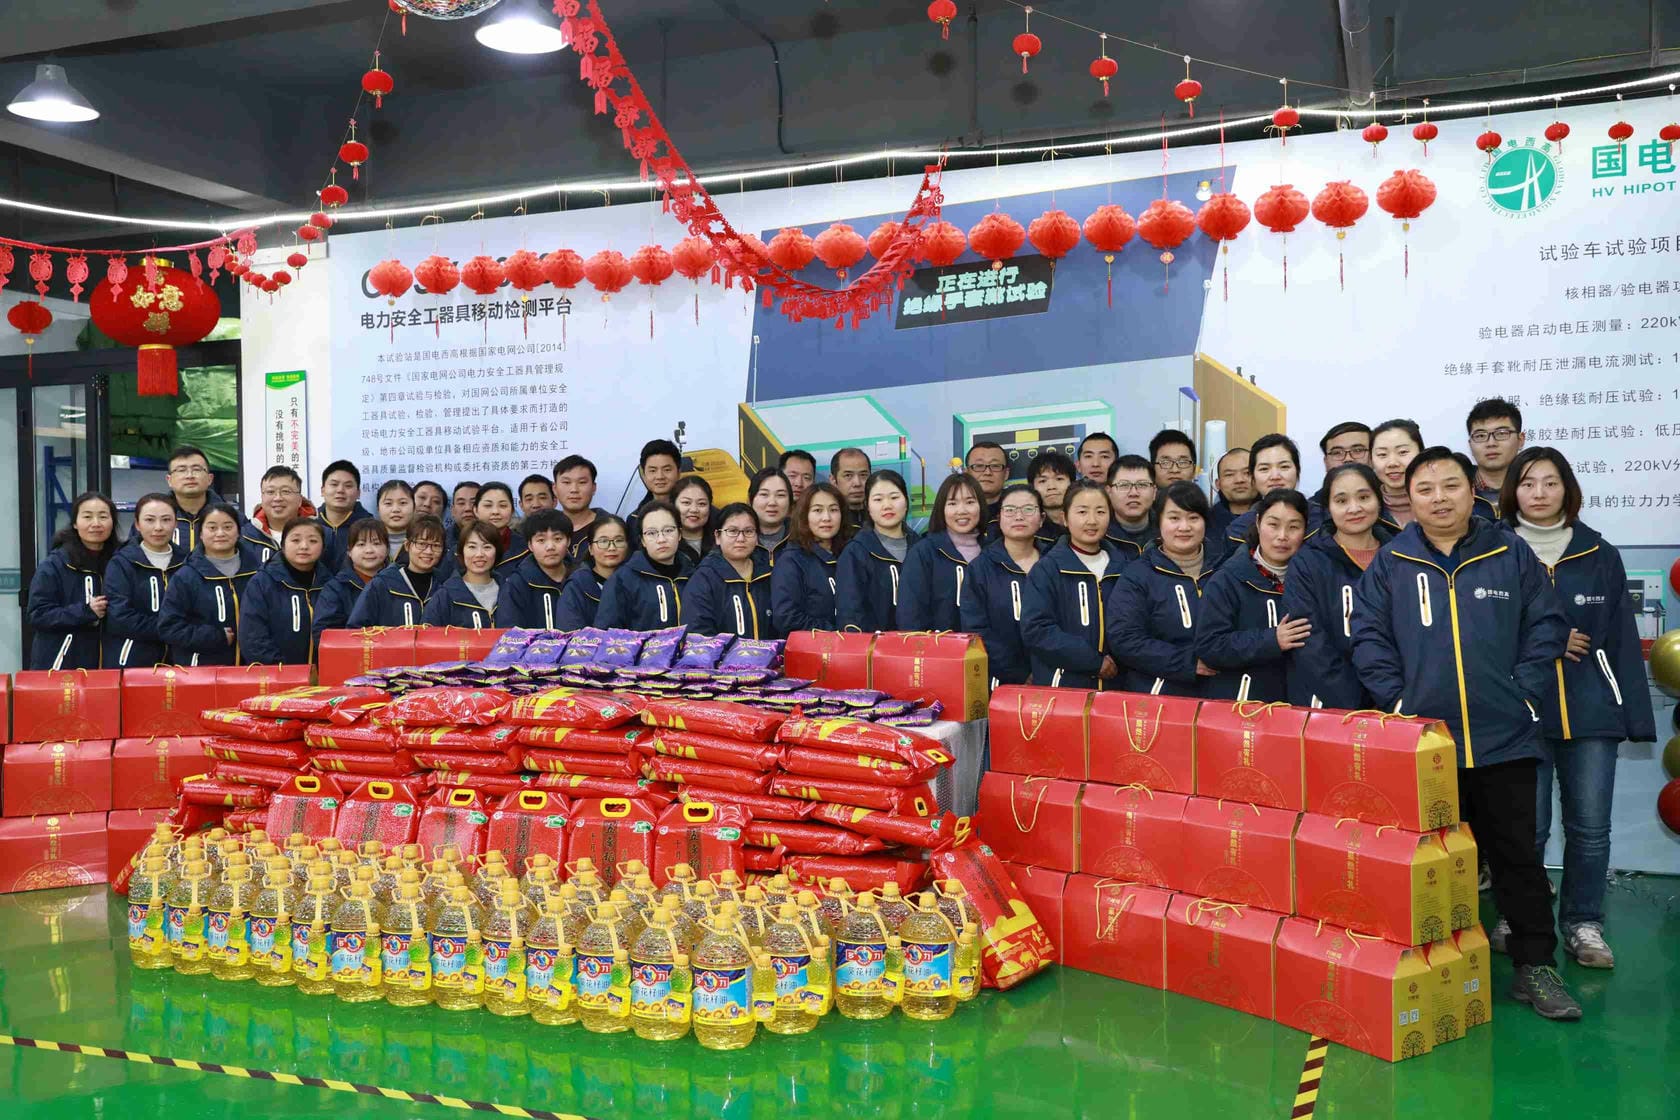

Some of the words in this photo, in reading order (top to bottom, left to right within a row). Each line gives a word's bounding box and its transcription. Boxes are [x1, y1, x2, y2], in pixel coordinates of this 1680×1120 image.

[1592, 139, 1677, 179] 国电
[1592, 186, 1615, 198] HV
[1624, 181, 1677, 196] HIPOT
[1539, 234, 1680, 261] 试验车试验项
[361, 297, 572, 329] 电力安全工器具移动检测平台
[1478, 316, 1680, 340] 验电器启动电压测量：220k
[1573, 459, 1680, 475] 试验，220kV
[1580, 492, 1680, 509] 具的拉力力
